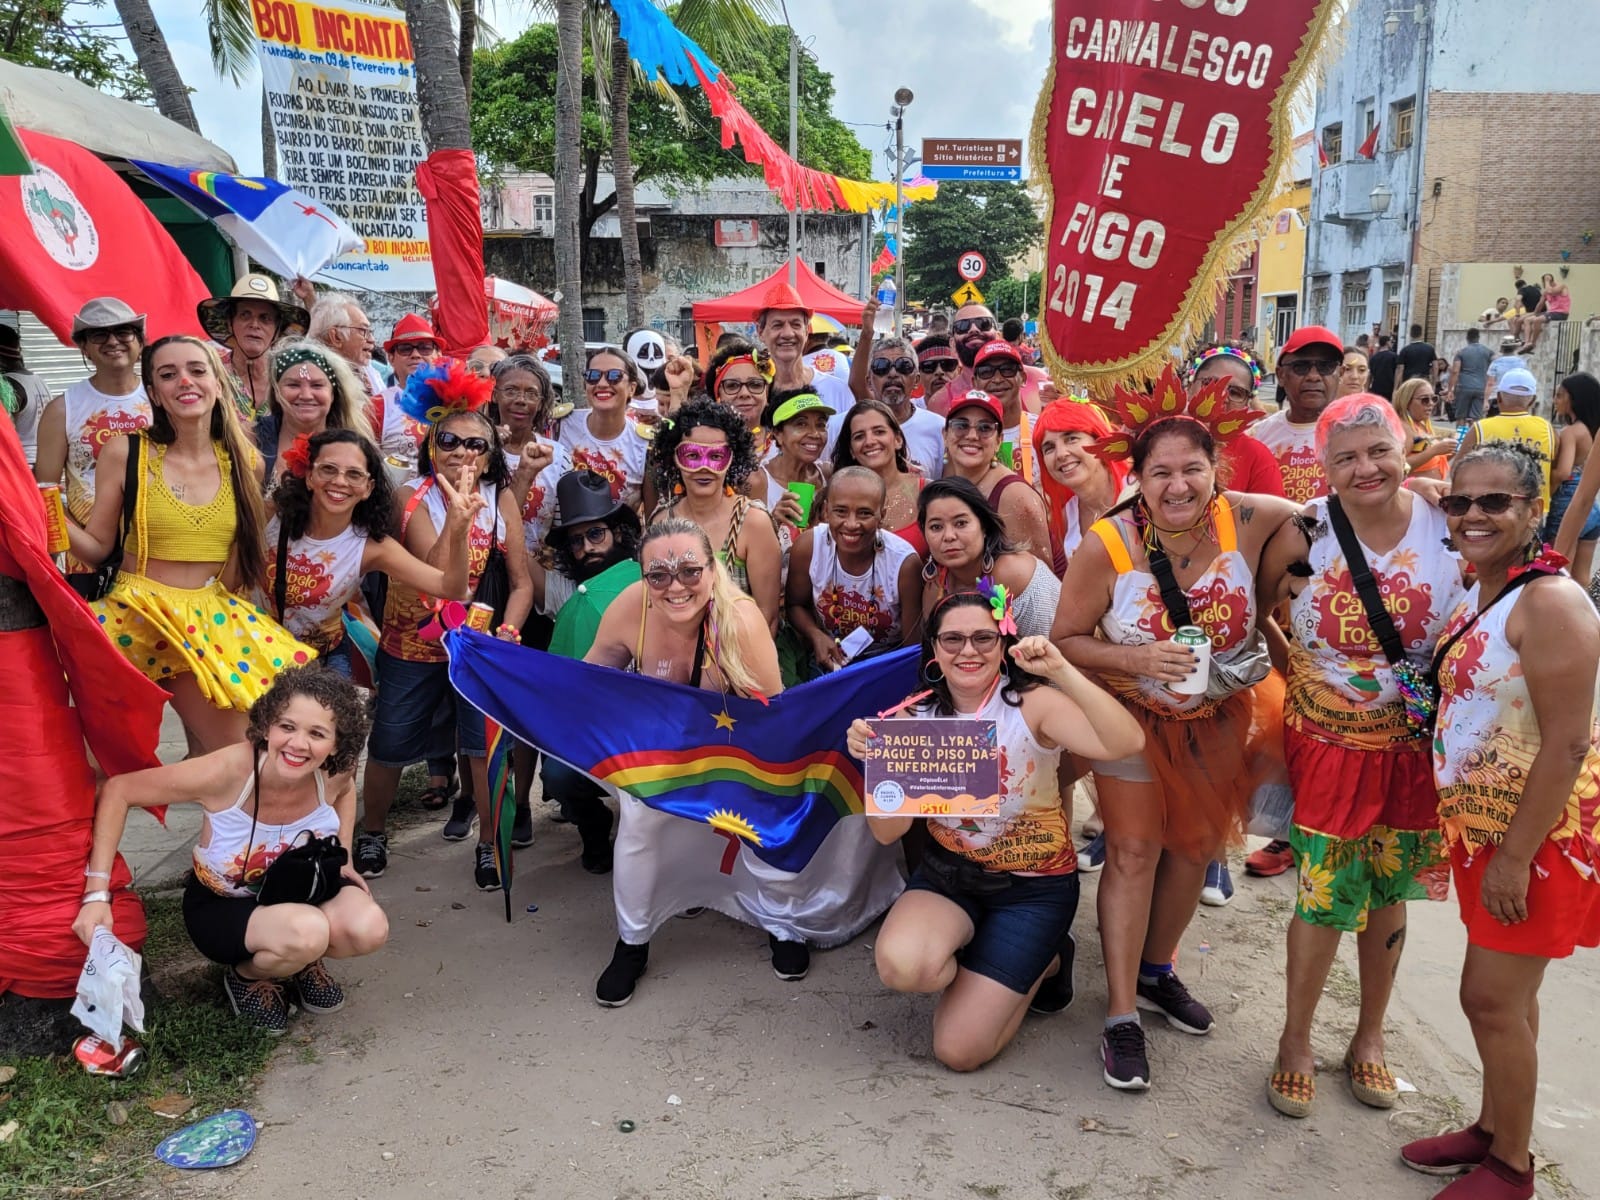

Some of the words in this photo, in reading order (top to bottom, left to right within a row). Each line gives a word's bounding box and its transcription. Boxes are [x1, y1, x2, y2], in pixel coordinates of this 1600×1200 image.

[253, 0, 301, 44] BOI
[262, 40, 306, 61] Fundado
[310, 54, 325, 65] em
[326, 53, 337, 66] 09
[338, 54, 349, 68] de
[352, 57, 396, 75] Fevereiro
[397, 63, 409, 77] de
[298, 76, 313, 92] AO
[318, 80, 350, 97] LAVAR
[354, 85, 366, 100] AS
[371, 87, 418, 105] PRIMEIRAS
[269, 91, 303, 110] ROUPAS
[305, 96, 325, 112] DOS
[327, 98, 357, 116] RECÉM
[359, 104, 399, 121] NASCIDOS
[401, 108, 415, 122] EM
[274, 111, 312, 130] CACIMBA
[314, 116, 326, 131] NO
[327, 116, 350, 134] SÍTIO
[352, 121, 364, 135] DE
[365, 122, 388, 137] DONA
[1066, 87, 1240, 164] CAELO
[277, 130, 311, 147] BAIRRO
[314, 134, 328, 148] DO
[368, 140, 407, 156] CONTAM
[411, 143, 422, 156] AS
[309, 152, 325, 167] QUE
[328, 153, 343, 168] UM
[346, 155, 390, 171] BOIZINHO
[311, 168, 345, 184] SEMPRE
[349, 171, 388, 188] APARECIA
[390, 175, 407, 189] NAS
[963, 169, 1004, 177] Prefeitura
[1098, 153, 1131, 199] E
[320, 186, 346, 201] FRIAS
[350, 187, 378, 203] DESTA
[380, 190, 408, 206] MESMA
[353, 205, 397, 220] AFIRMAM
[400, 208, 417, 222] SER
[1060, 201, 1166, 270] FOGO
[373, 240, 387, 254] BOI
[391, 241, 430, 256] INCANTA
[962, 258, 982, 271] 30
[1049, 263, 1137, 331] 2014
[109, 420, 136, 430] bloco
[586, 457, 607, 469] bloco
[1290, 456, 1315, 466] bloco
[1296, 477, 1310, 487] de
[286, 559, 310, 573] bloco
[266, 563, 317, 589] Cbelo
[287, 583, 300, 594] de
[843, 597, 867, 611] bloco
[1330, 591, 1411, 616] Calo
[1161, 600, 1232, 634] Cbelo
[1339, 615, 1383, 651] Fog
[1367, 706, 1387, 720] TODA
[885, 736, 934, 746] RAQUEL
[874, 749, 916, 759] PAGUE
[921, 749, 931, 759] O
[936, 749, 966, 759] PISO
[972, 749, 989, 759] DA
[887, 762, 976, 773] ENFERMAGEM
[1480, 785, 1490, 797] DE
[1492, 787, 1520, 804] OPRES
[920, 803, 950, 814] PSTU
[1486, 806, 1513, 825] REVOL
[1016, 837, 1022, 846] DE
